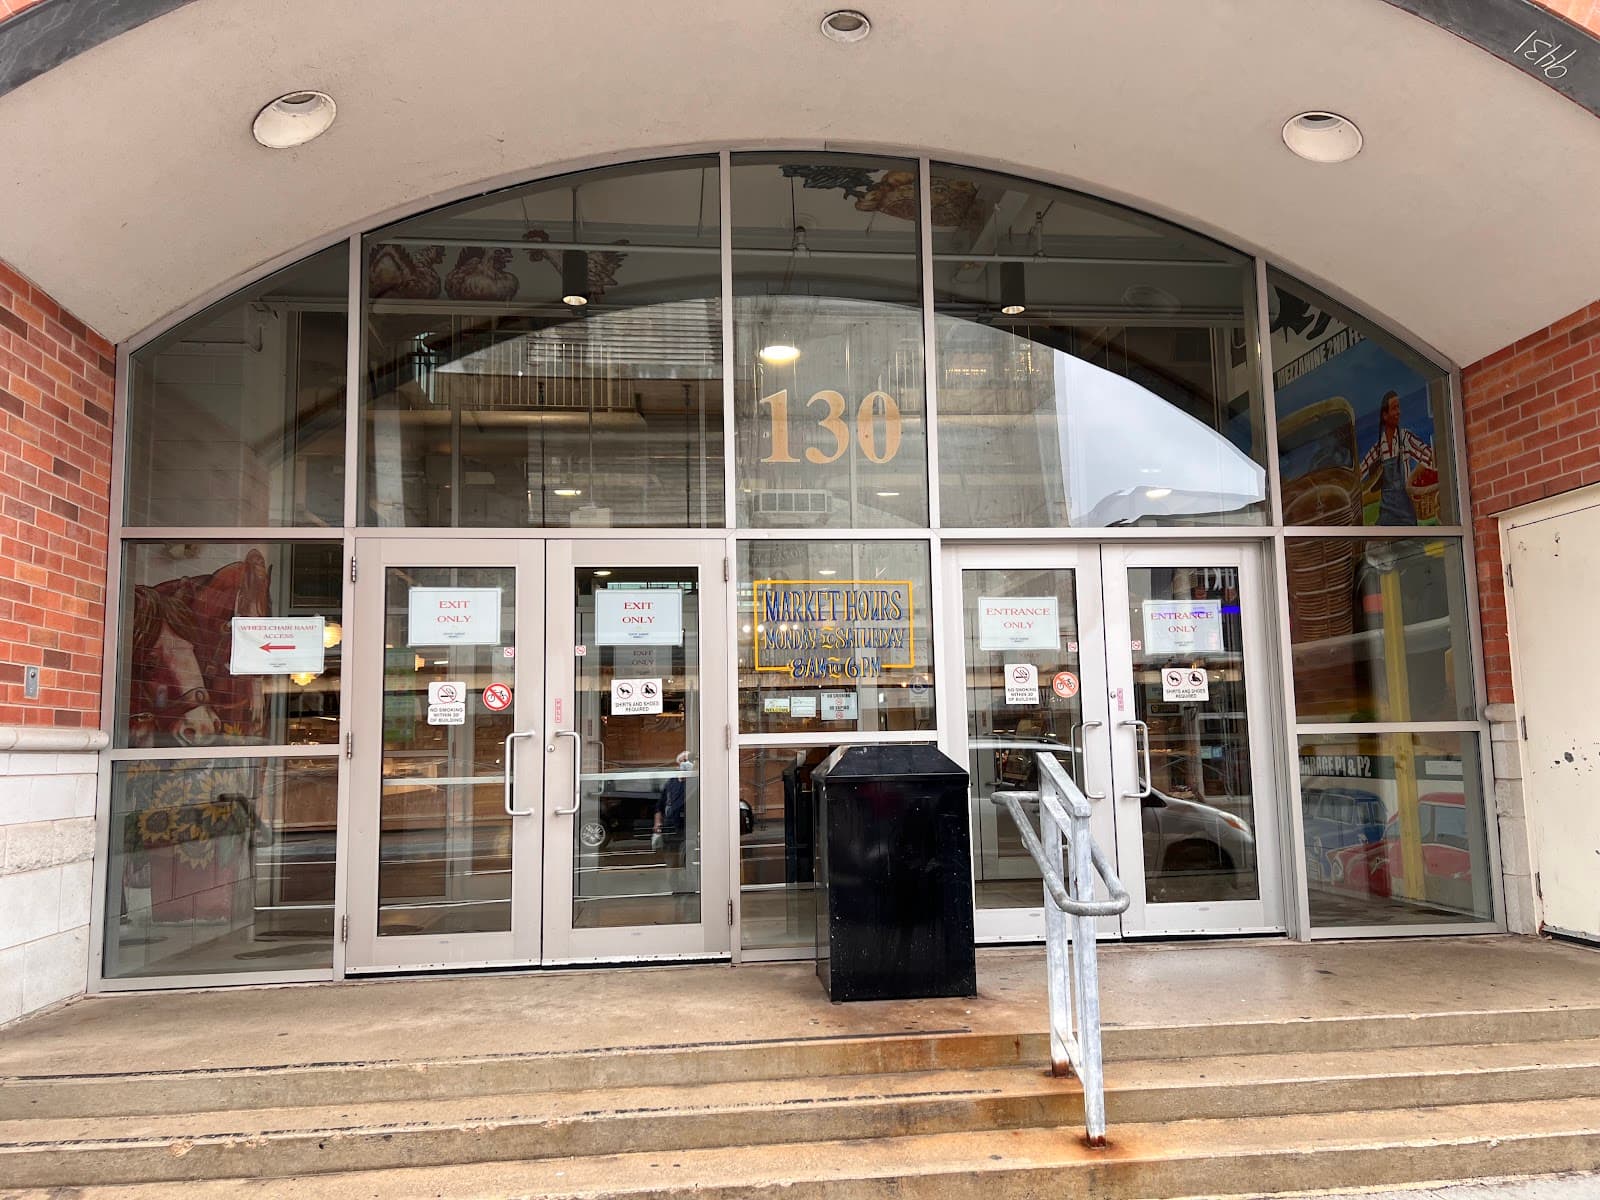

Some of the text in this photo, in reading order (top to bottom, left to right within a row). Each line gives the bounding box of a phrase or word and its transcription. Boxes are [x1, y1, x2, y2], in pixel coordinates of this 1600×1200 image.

[760, 388, 902, 464] 130
[439, 600, 471, 609] EXIT
[623, 601, 654, 610] EXIT
[763, 590, 903, 622] MARKET HOURS
[986, 607, 1050, 616] ENTRANCE
[1150, 611, 1214, 620] ENTRANCE
[437, 615, 472, 623] ONLY
[622, 616, 655, 624] ONLY
[1003, 621, 1034, 629] ONLY
[1168, 625, 1198, 633] ONLY
[763, 627, 819, 650] MONDAY
[836, 627, 906, 649] SATURDAY
[1357, 755, 1372, 777] P2
